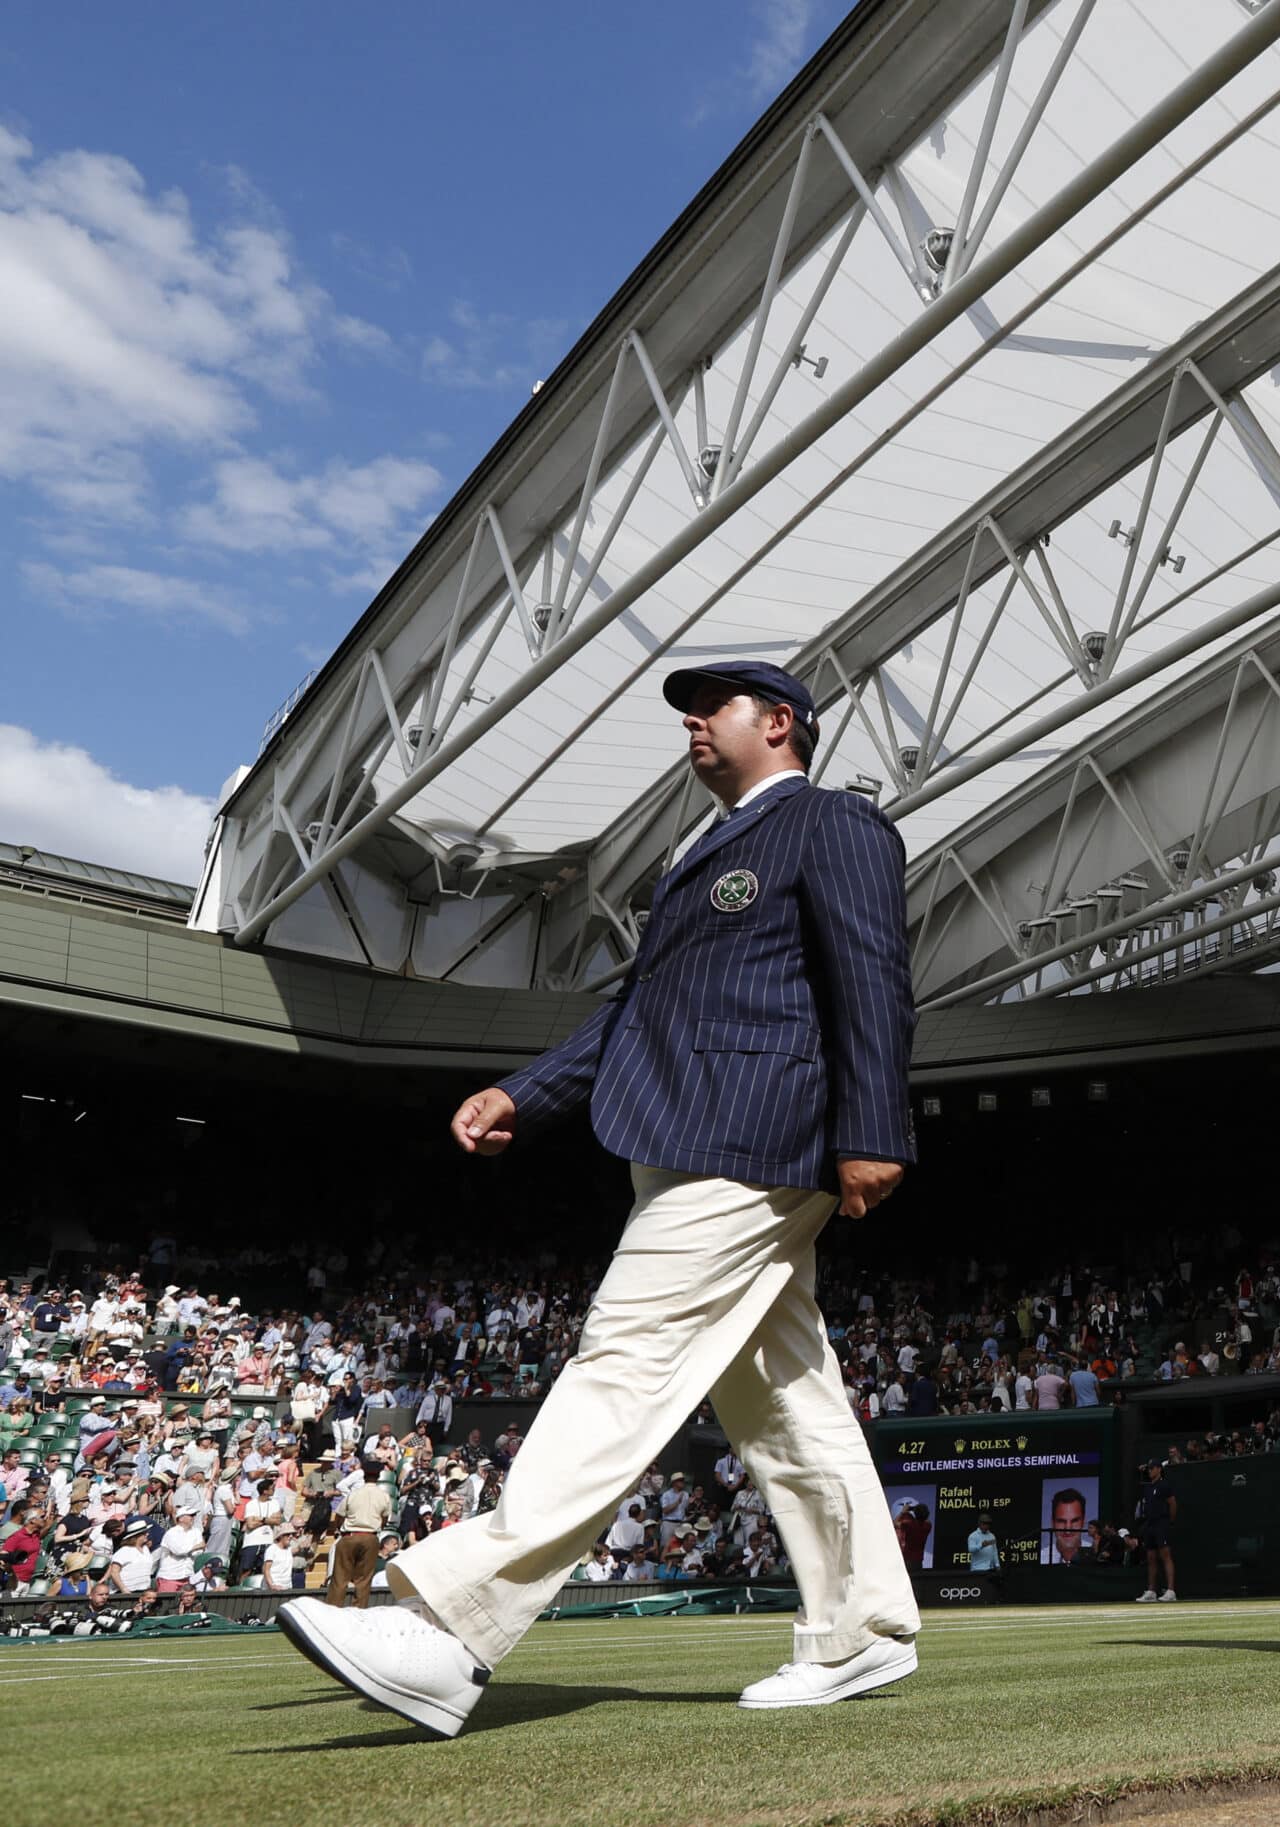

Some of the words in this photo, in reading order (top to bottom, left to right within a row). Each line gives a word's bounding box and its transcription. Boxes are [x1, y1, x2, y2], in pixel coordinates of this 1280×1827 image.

[898, 1442, 925, 1454] 4.27
[970, 1439, 1011, 1450] ROLEX
[902, 1458, 974, 1472] GENTLEMEN'S
[977, 1456, 1021, 1469] SINGLES
[1024, 1454, 1080, 1467] SEMIFINAL
[940, 1486, 973, 1497] Rafael
[939, 1498, 976, 1509] NADAL
[978, 1499, 990, 1510] (3)
[993, 1498, 1011, 1507] ESP
[952, 1551, 1006, 1564] FEDR
[1023, 1552, 1038, 1561] SUI
[940, 1587, 981, 1600] oppo
